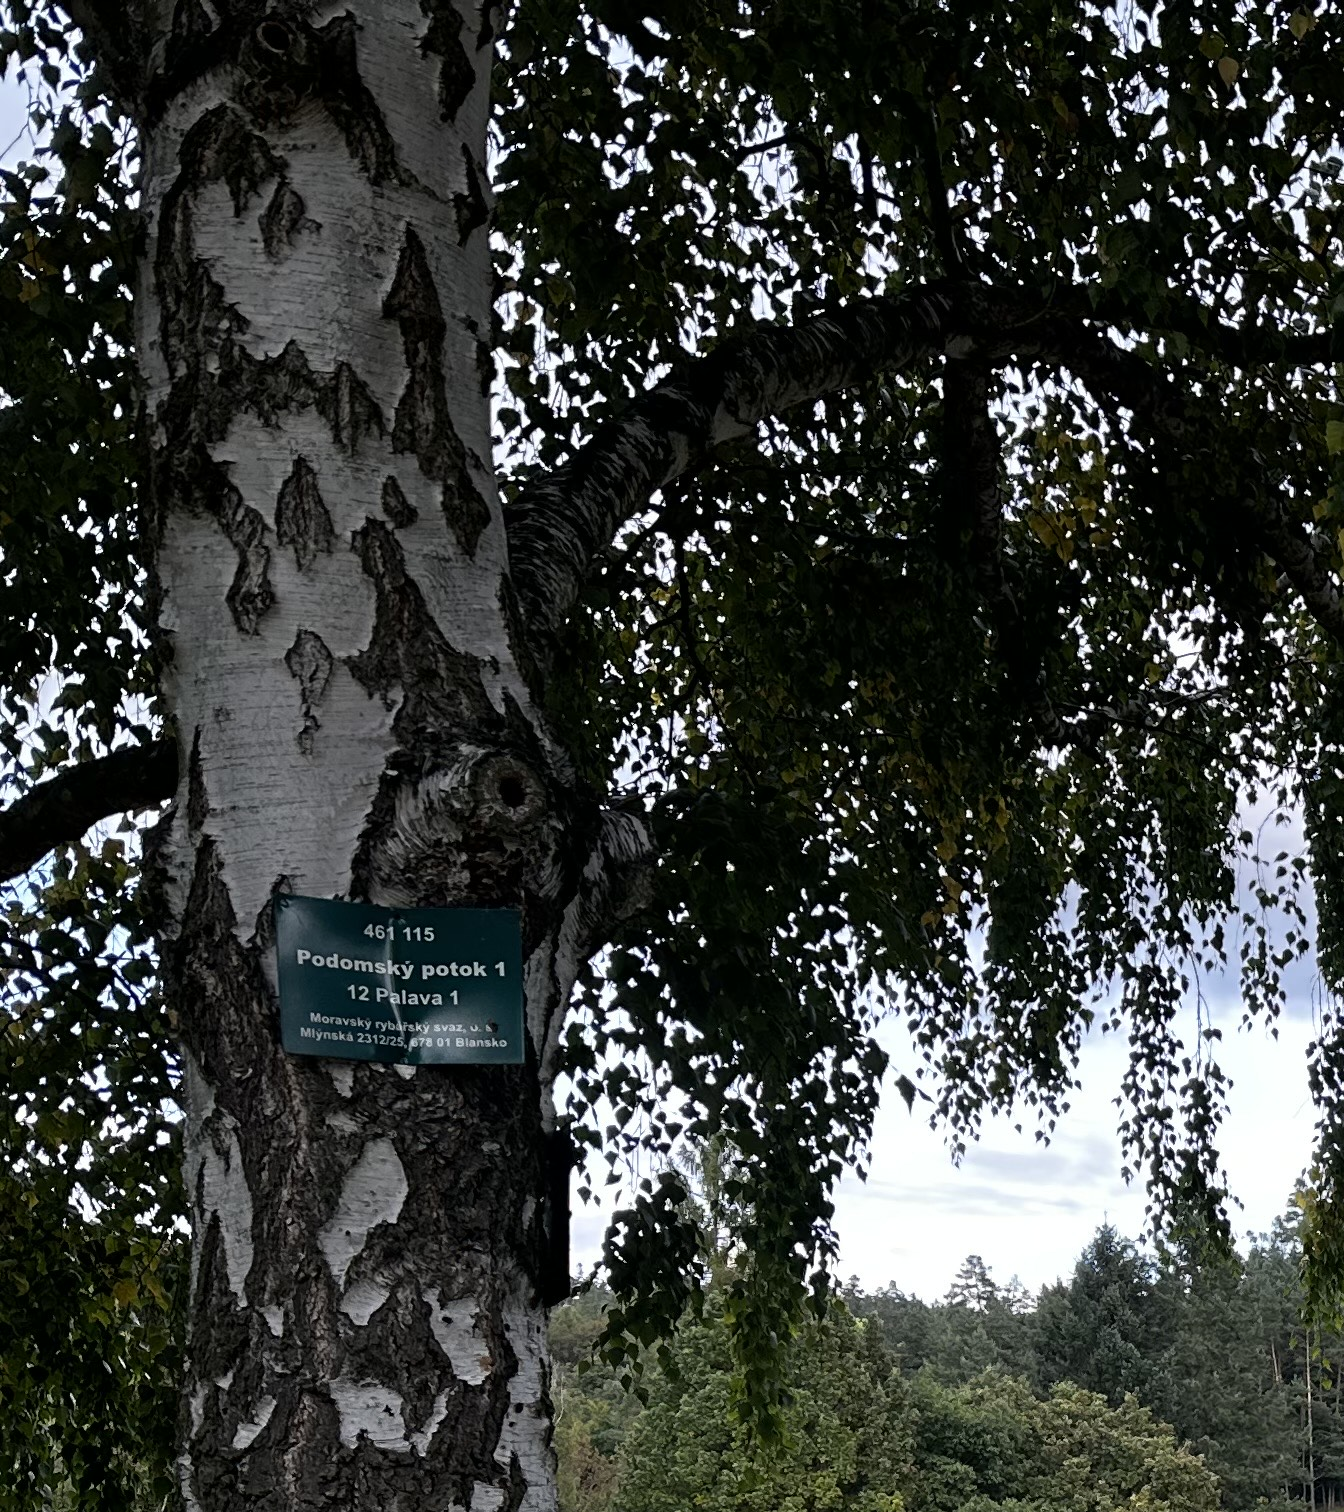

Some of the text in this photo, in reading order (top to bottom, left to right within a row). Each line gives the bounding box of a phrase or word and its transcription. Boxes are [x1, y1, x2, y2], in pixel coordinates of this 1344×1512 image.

[363, 923, 435, 942] 461 115
[296, 949, 506, 980] Podomský potok 1
[347, 984, 459, 1006] 12 Palava 1
[310, 1012, 372, 1031] Moravský
[433, 1023, 467, 1034] svaz,
[300, 1027, 354, 1041] Mlýnská
[357, 1032, 407, 1049] 2312/25,
[436, 1038, 451, 1047] 01
[455, 1037, 507, 1048] Blansko
